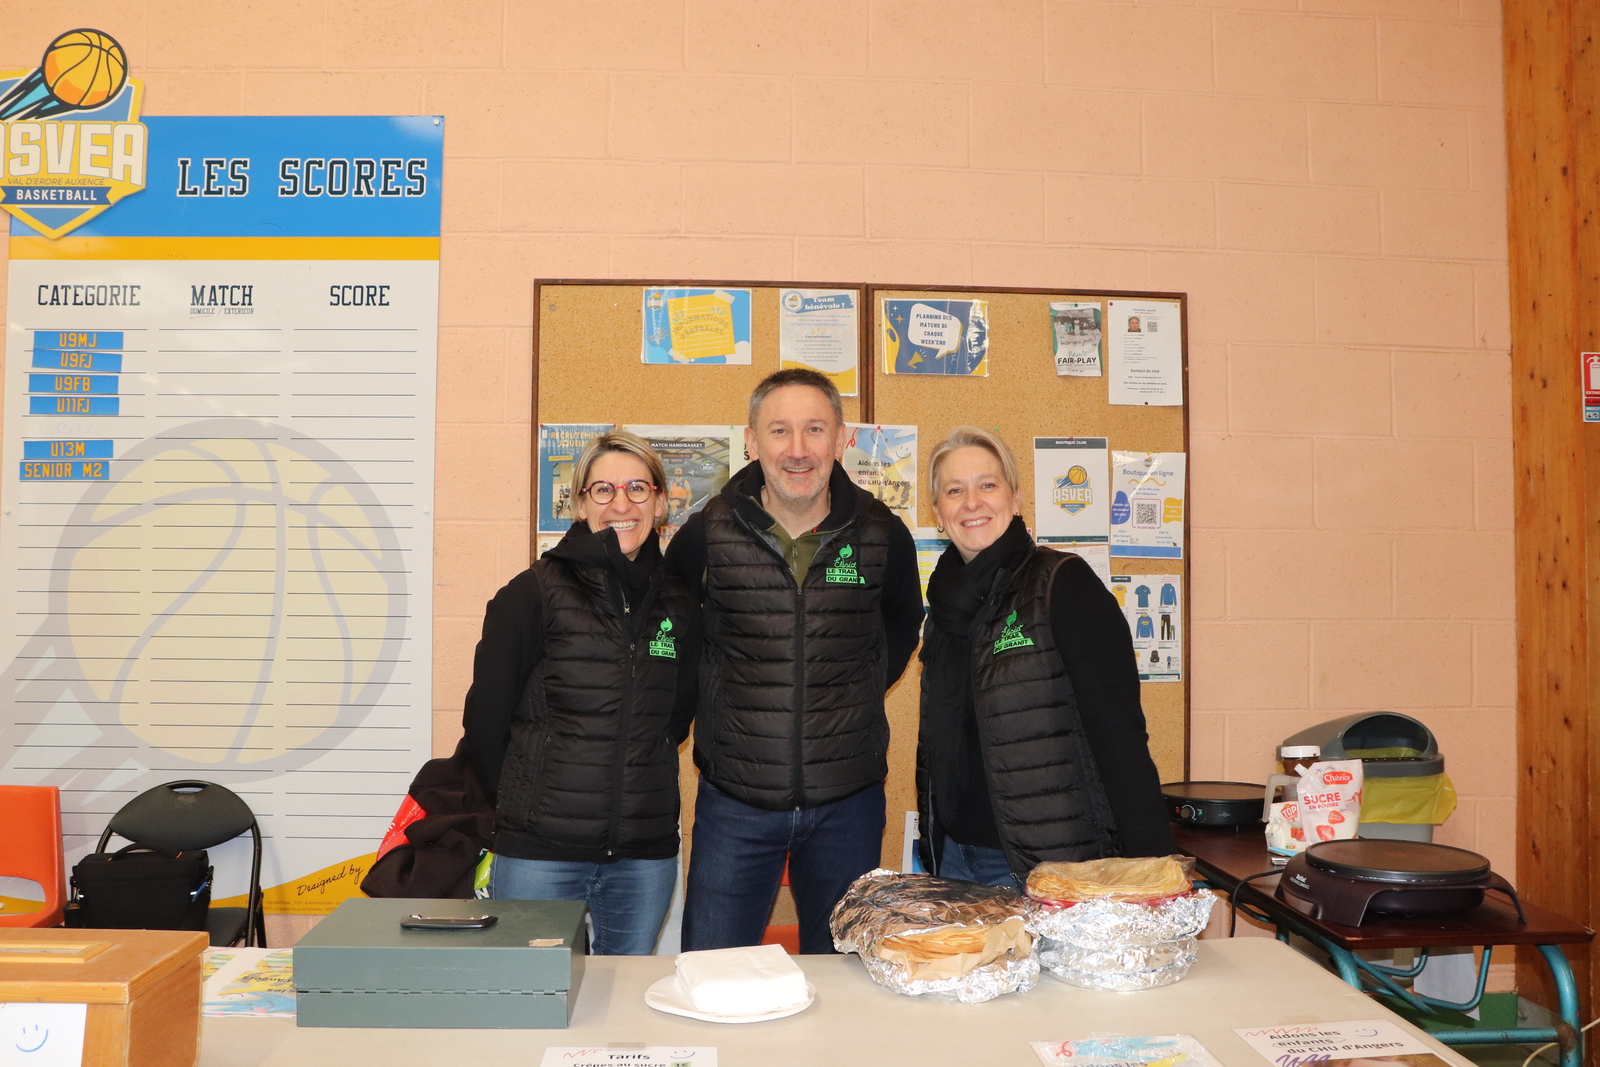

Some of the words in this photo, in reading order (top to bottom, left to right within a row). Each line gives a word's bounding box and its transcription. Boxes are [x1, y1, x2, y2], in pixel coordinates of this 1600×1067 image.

[0, 123, 144, 186] SVEA
[64, 178, 106, 186] AUXENCE
[176, 158, 250, 198] LES
[278, 158, 427, 198] SCORES
[16, 189, 97, 201] BASKETBALL
[38, 285, 140, 306] CATEGORIE
[191, 285, 253, 306] MATCH
[330, 285, 390, 306] SCORE
[59, 332, 97, 348] U9MJ
[60, 352, 93, 368] U9FJ
[55, 376, 91, 391] U9FB
[57, 397, 91, 413] U11FJ
[51, 442, 85, 457] U13M
[24, 462, 72, 478] SENIOR
[83, 462, 103, 478] M2
[1122, 468, 1148, 477] Boutiqu
[1053, 488, 1092, 503] ASVEA
[1003, 639, 1029, 649] GRANIT
[1303, 792, 1341, 805] SUCRE
[1282, 805, 1297, 817] TOP
[296, 865, 347, 896] Designed
[348, 864, 364, 885] by
[1269, 1031, 1317, 1040] Aidons
[1278, 1038, 1334, 1047] enfants
[1308, 1045, 1339, 1053] CHU
[1341, 1041, 1404, 1051] d'Angers
